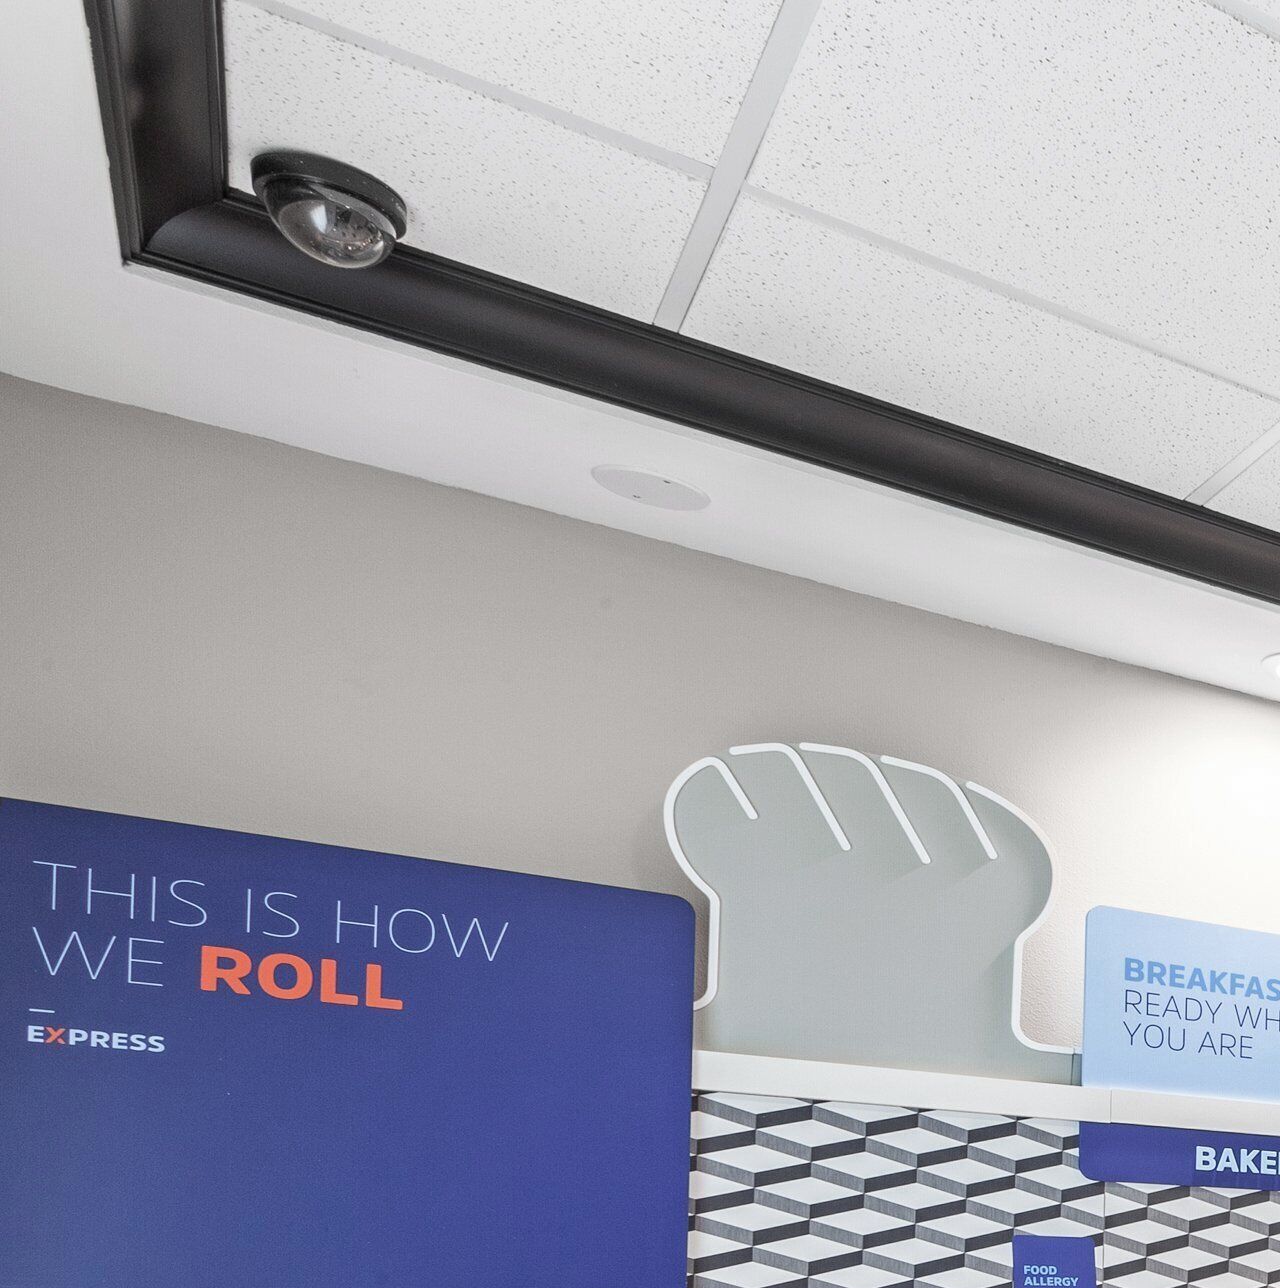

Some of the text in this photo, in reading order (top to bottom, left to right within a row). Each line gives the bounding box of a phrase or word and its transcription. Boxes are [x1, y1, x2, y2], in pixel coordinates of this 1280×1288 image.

[33, 861, 509, 962] THIS IS HOW
[33, 927, 403, 1011] WE ROLL
[1123, 989, 1222, 1024] READY
[27, 1025, 166, 1054] EXPRESS
[1122, 1021, 1254, 1060] YOU ARE
[1023, 1265, 1057, 1275] FOOD
[1024, 1276, 1079, 1287] ALLERGY
